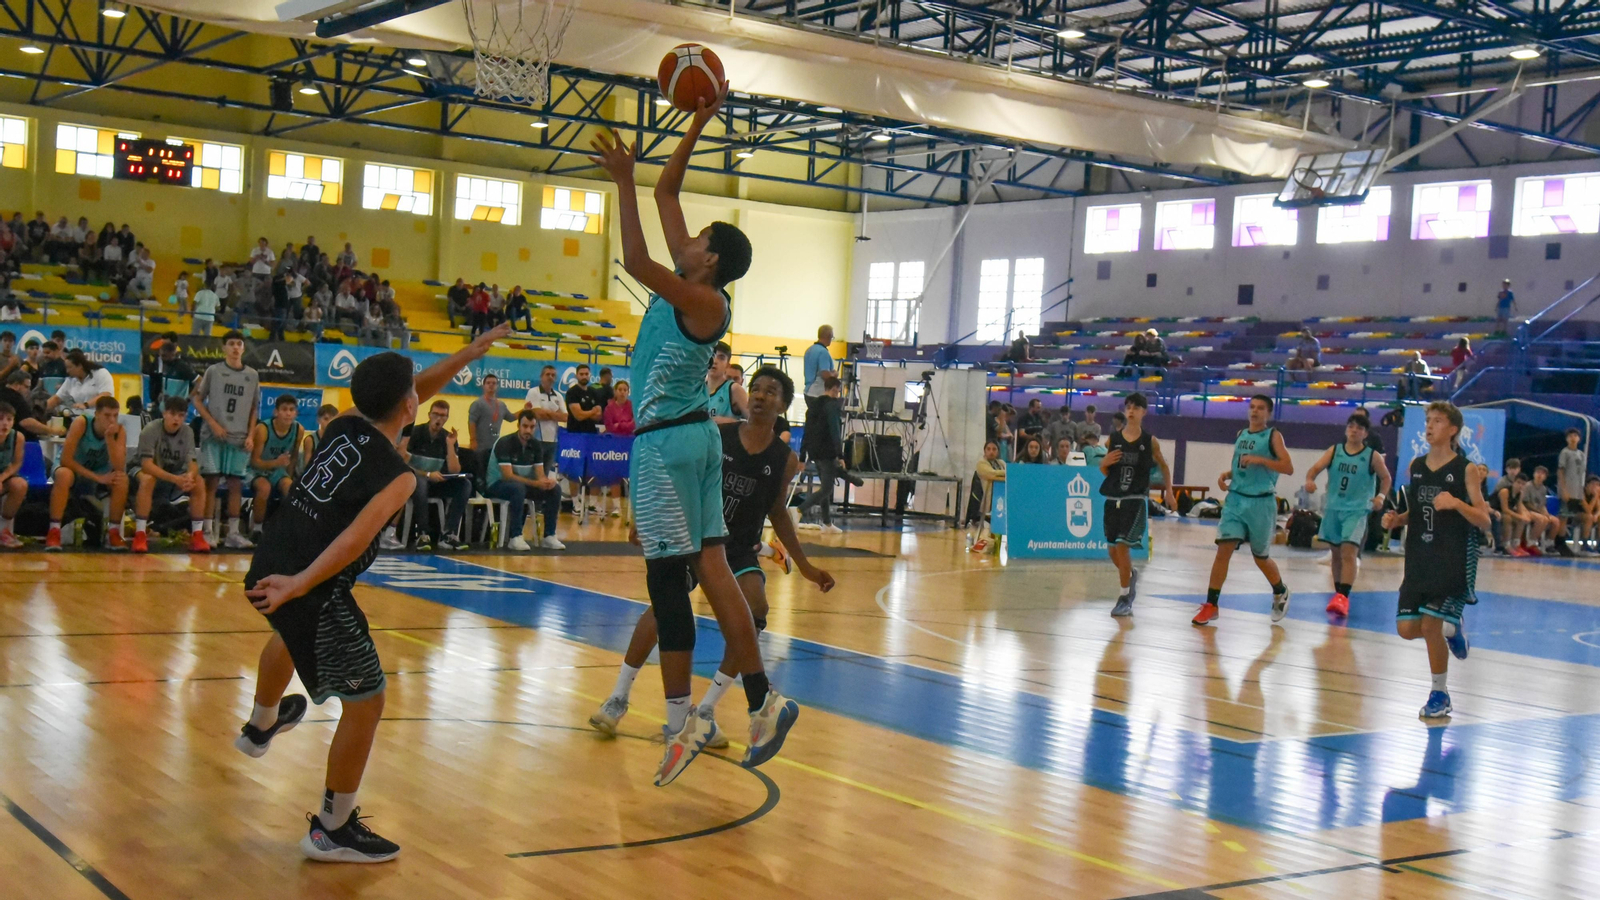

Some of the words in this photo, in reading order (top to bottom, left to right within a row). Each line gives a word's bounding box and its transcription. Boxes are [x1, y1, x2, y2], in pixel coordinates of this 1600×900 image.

[64, 337, 126, 352] aloncesto
[475, 367, 510, 378] BASKET
[476, 377, 531, 390] SENIBLE
[227, 398, 236, 413] 8
[592, 450, 628, 461] molten
[1338, 462, 1358, 475] MLG
[1340, 476, 1349, 491] 9
[291, 497, 318, 520] EVILLA
[1027, 539, 1085, 551] Ayuntamiento
[1086, 540, 1097, 550] de
